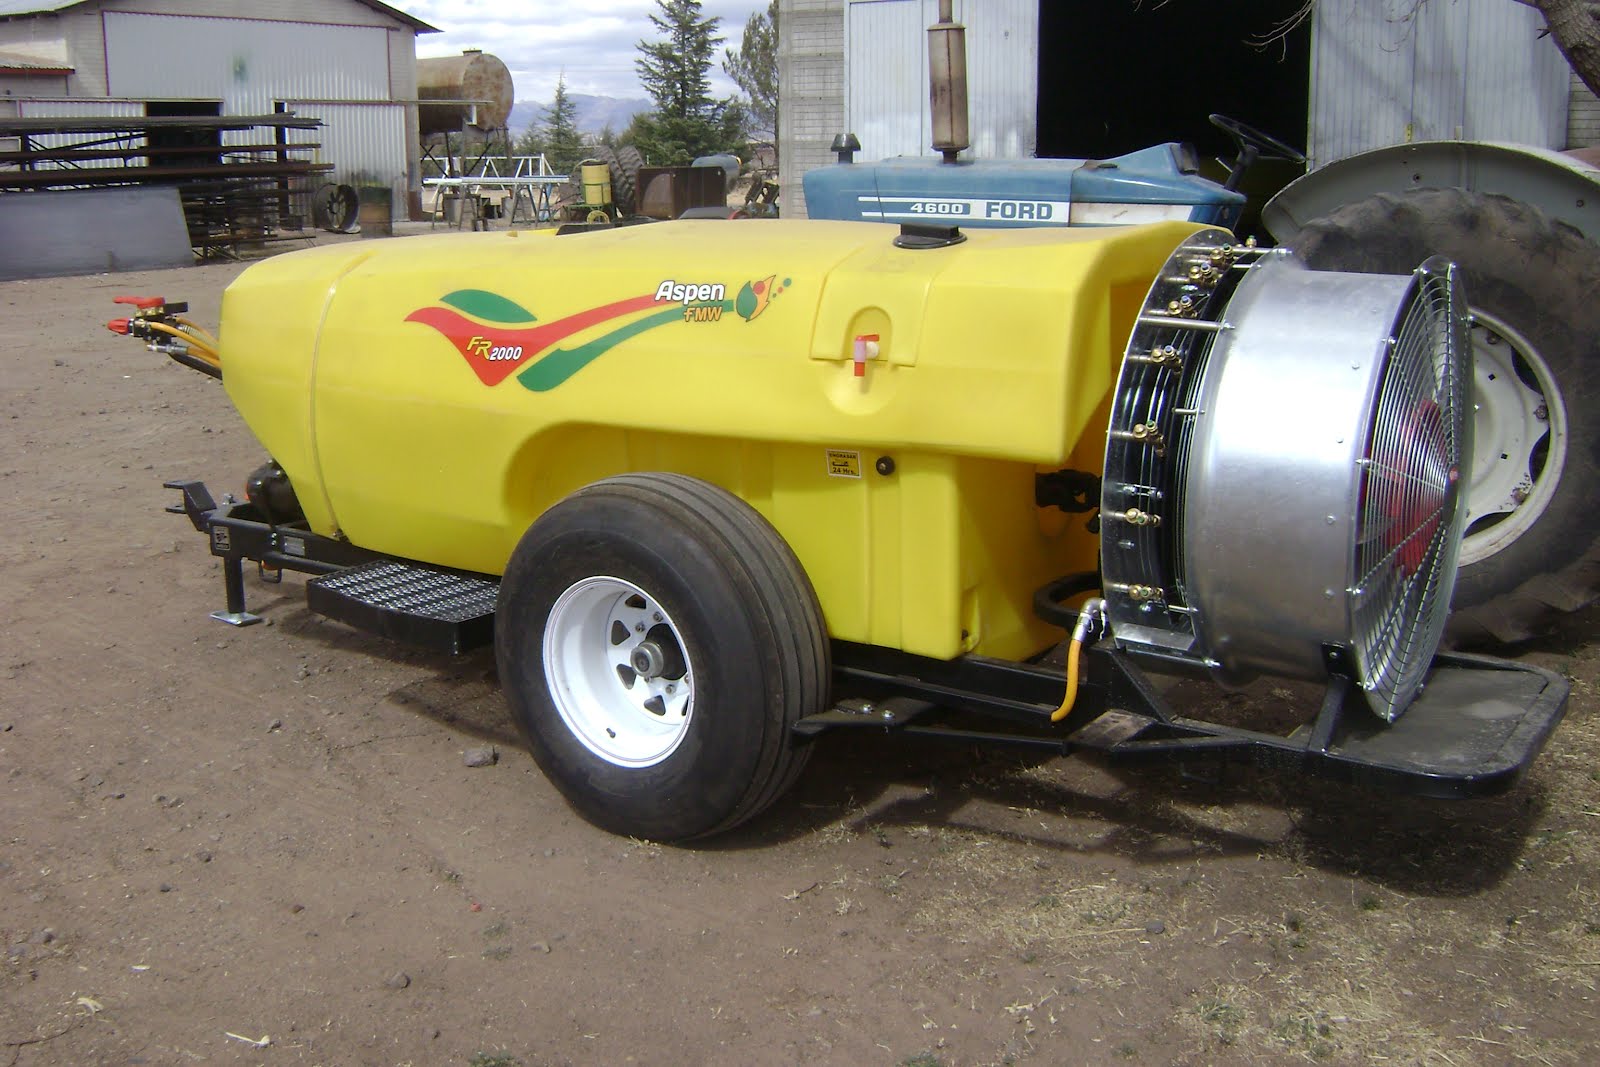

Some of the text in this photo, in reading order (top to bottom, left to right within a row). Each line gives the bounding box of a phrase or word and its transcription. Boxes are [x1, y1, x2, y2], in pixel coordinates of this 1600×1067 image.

[910, 201, 1053, 220] 4600 FORD
[654, 279, 726, 306] Aspen
[684, 306, 722, 322] FMW
[489, 345, 523, 361] 2000
